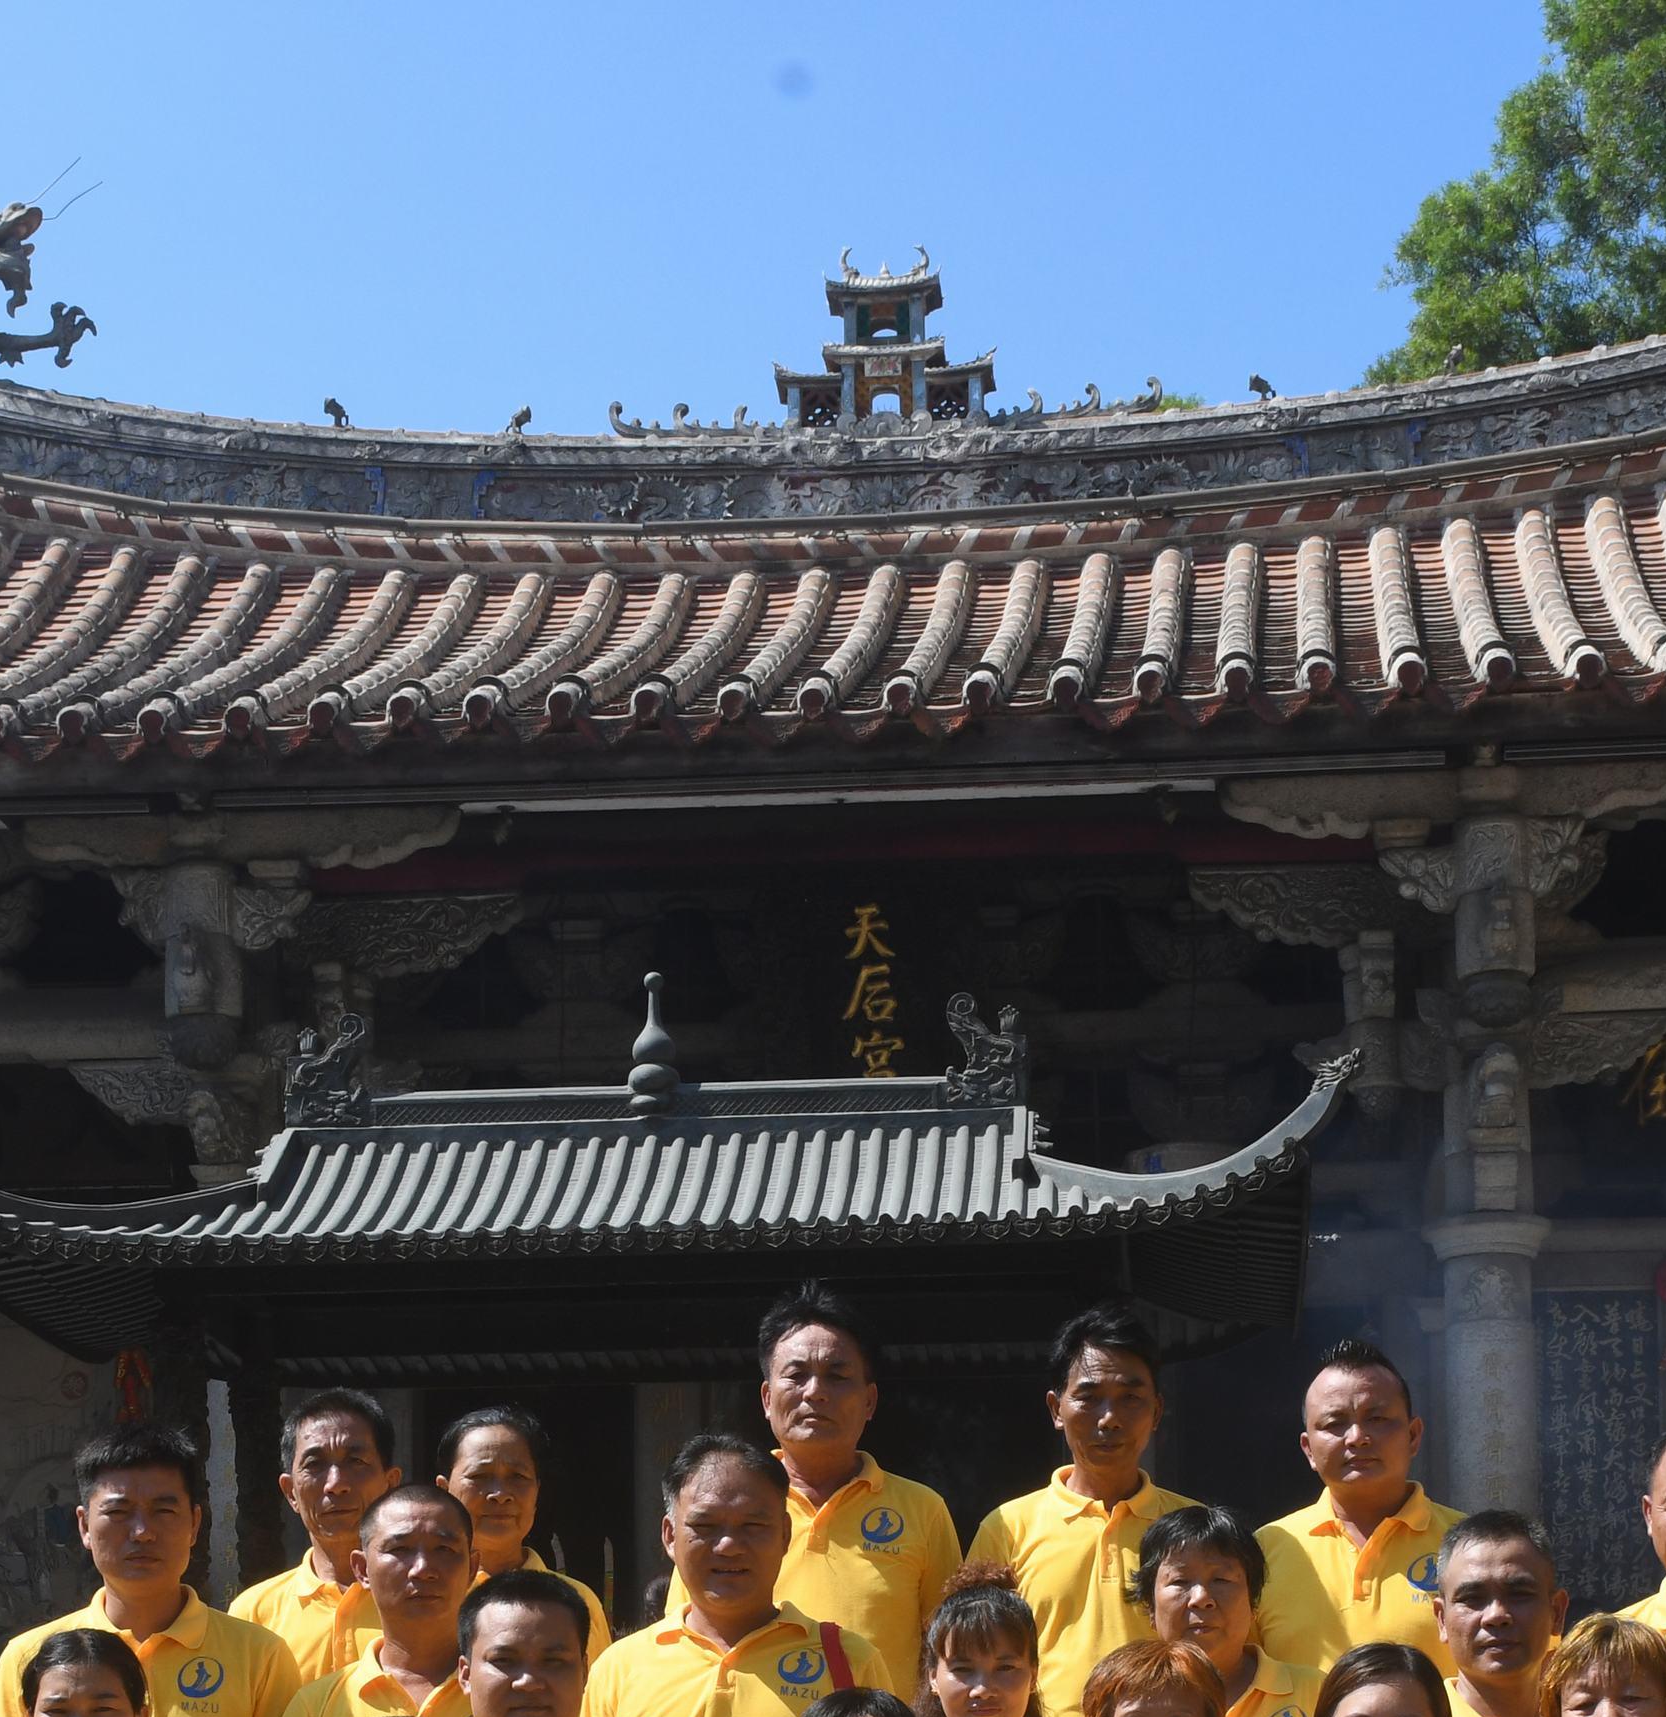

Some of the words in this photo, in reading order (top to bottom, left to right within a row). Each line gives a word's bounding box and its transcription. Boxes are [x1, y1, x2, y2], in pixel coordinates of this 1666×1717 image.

[842, 902, 905, 1078] 天后宮
[862, 1541, 901, 1556] MAZU
[779, 1685, 820, 1701] MAZU
[180, 1700, 220, 1714] MAZU
